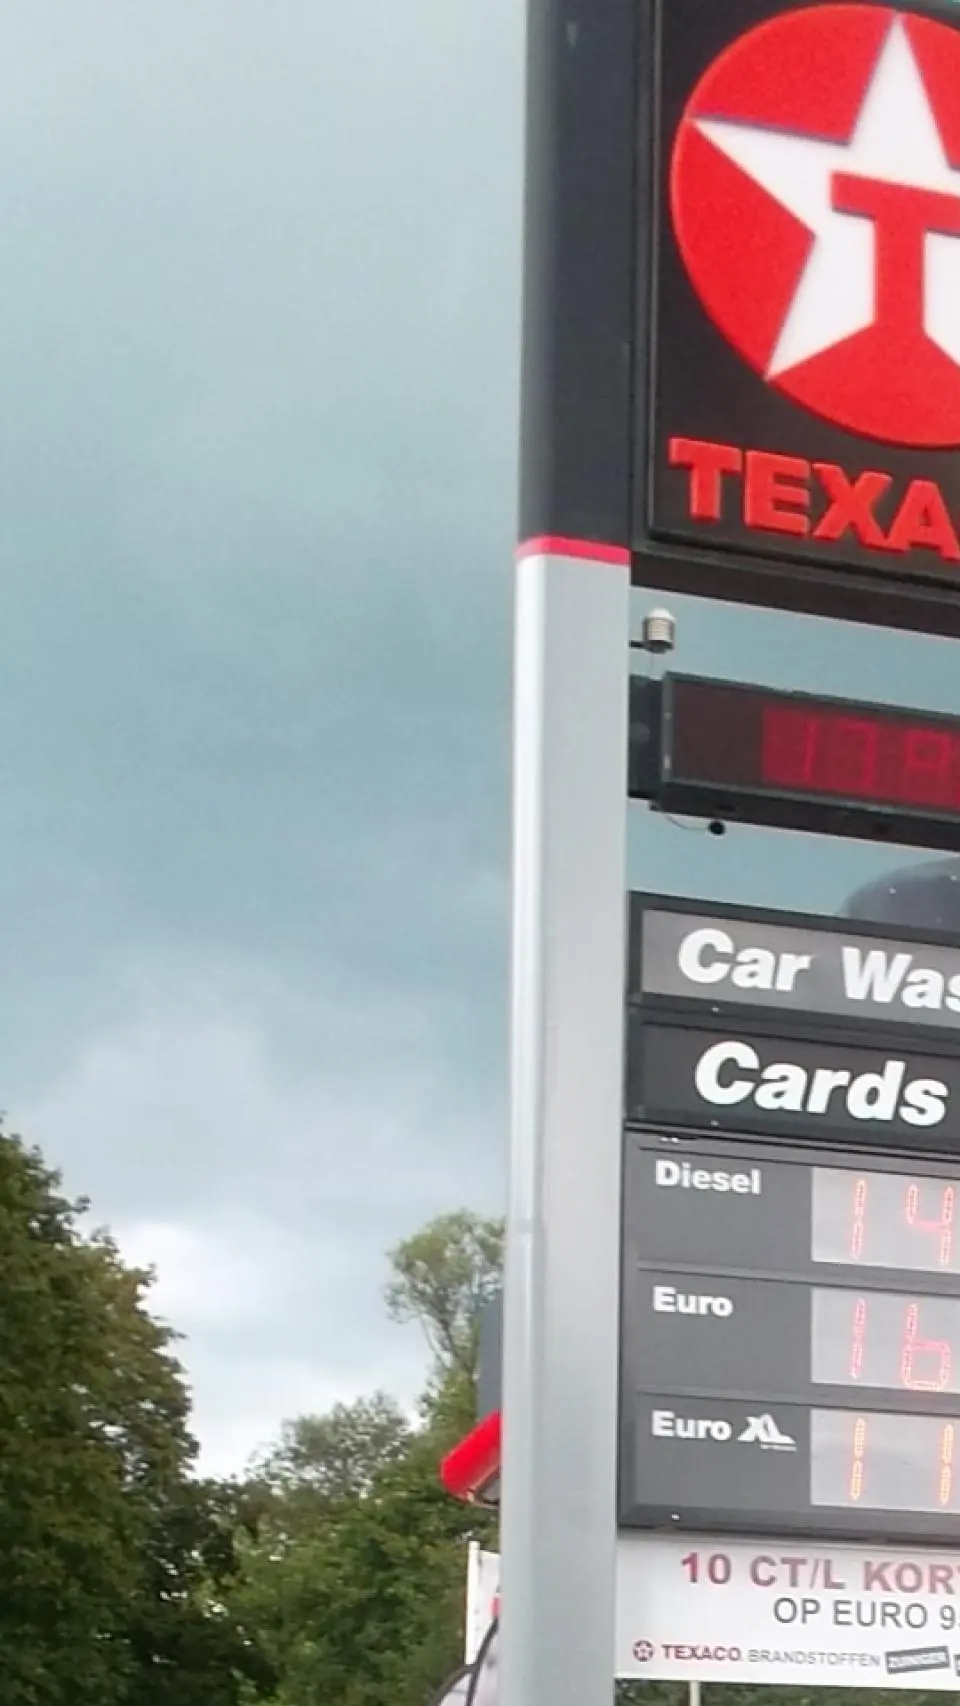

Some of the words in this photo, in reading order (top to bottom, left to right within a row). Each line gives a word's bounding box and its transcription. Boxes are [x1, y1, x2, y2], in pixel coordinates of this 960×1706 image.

[678, 929, 810, 992] Car
[695, 1042, 948, 1126] Cards
[655, 1161, 761, 1194] Diesel
[653, 1286, 733, 1317] Euro
[651, 1410, 731, 1441] Euro
[681, 1552, 731, 1585] 10
[749, 1554, 845, 1590] CT/L
[773, 1598, 820, 1624] OP
[833, 1601, 927, 1630] EURO
[662, 1645, 741, 1661] TEXACO
[748, 1647, 880, 1668] BRANDSTOFFEN
